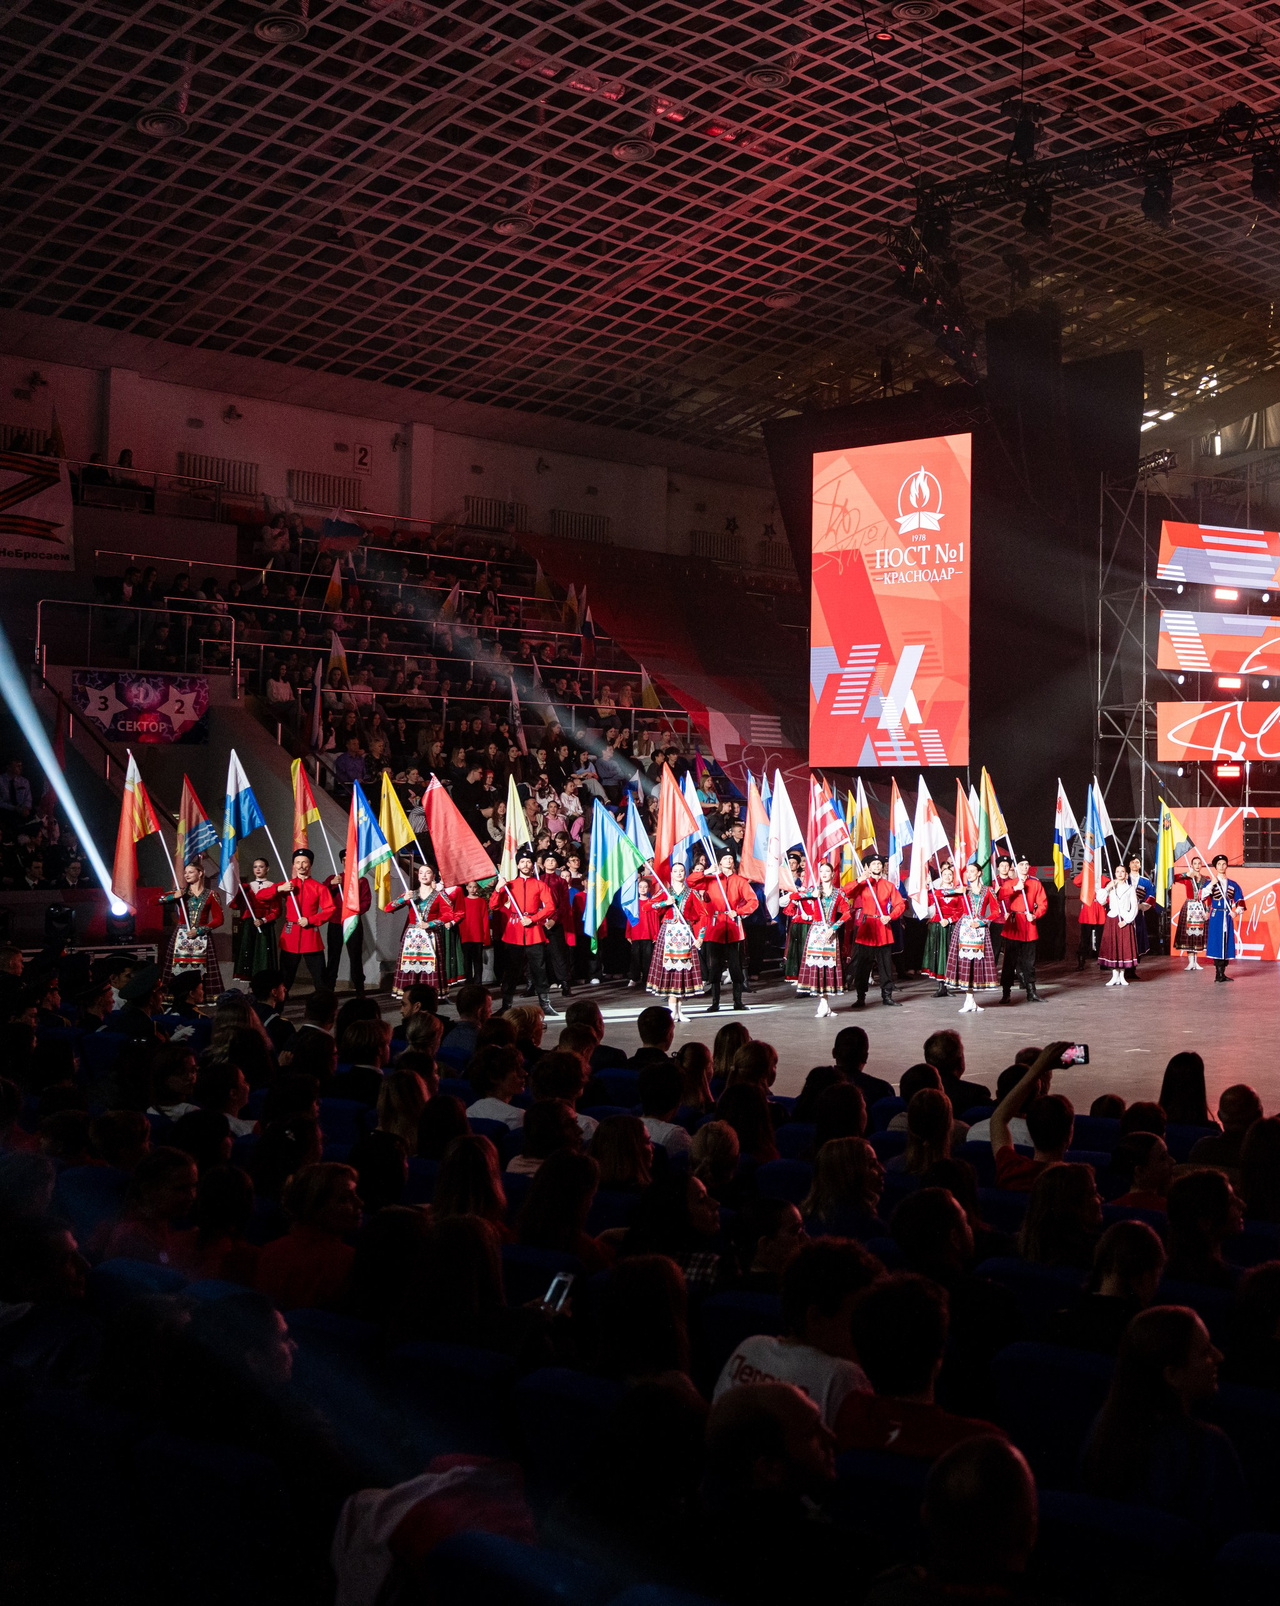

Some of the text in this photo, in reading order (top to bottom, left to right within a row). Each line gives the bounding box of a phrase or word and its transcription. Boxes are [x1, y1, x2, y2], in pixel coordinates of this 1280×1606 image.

[358, 447, 368, 466] 2
[912, 534, 926, 542] 1978
[875, 545, 931, 569] ПОСТ
[98, 696, 109, 711] 3
[174, 700, 185, 714] 2
[117, 721, 167, 732] СЕКТОР
